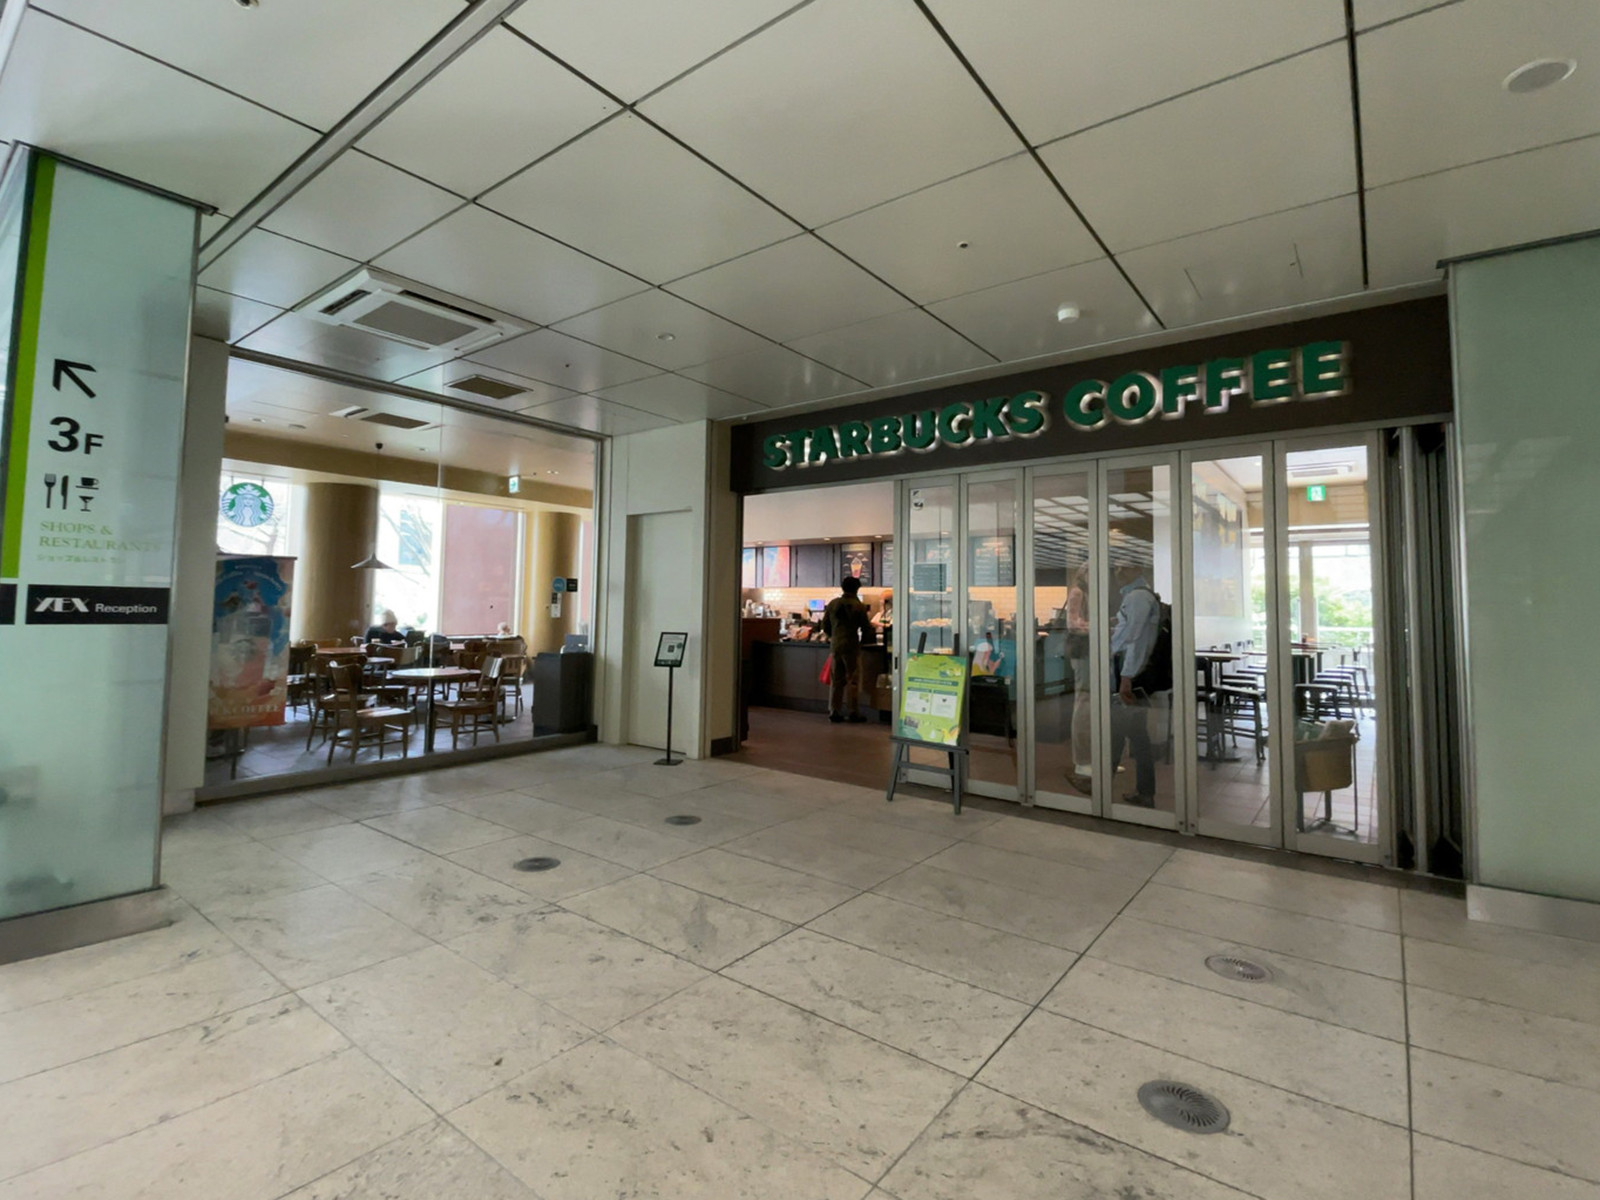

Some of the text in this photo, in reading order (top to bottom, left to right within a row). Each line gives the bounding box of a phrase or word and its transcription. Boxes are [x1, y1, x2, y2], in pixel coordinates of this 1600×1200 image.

[763, 340, 1350, 471] STARBUCKS COFFEE
[48, 416, 104, 455] 3F
[40, 521, 113, 536] SHOPS &
[95, 603, 158, 615] Reception
